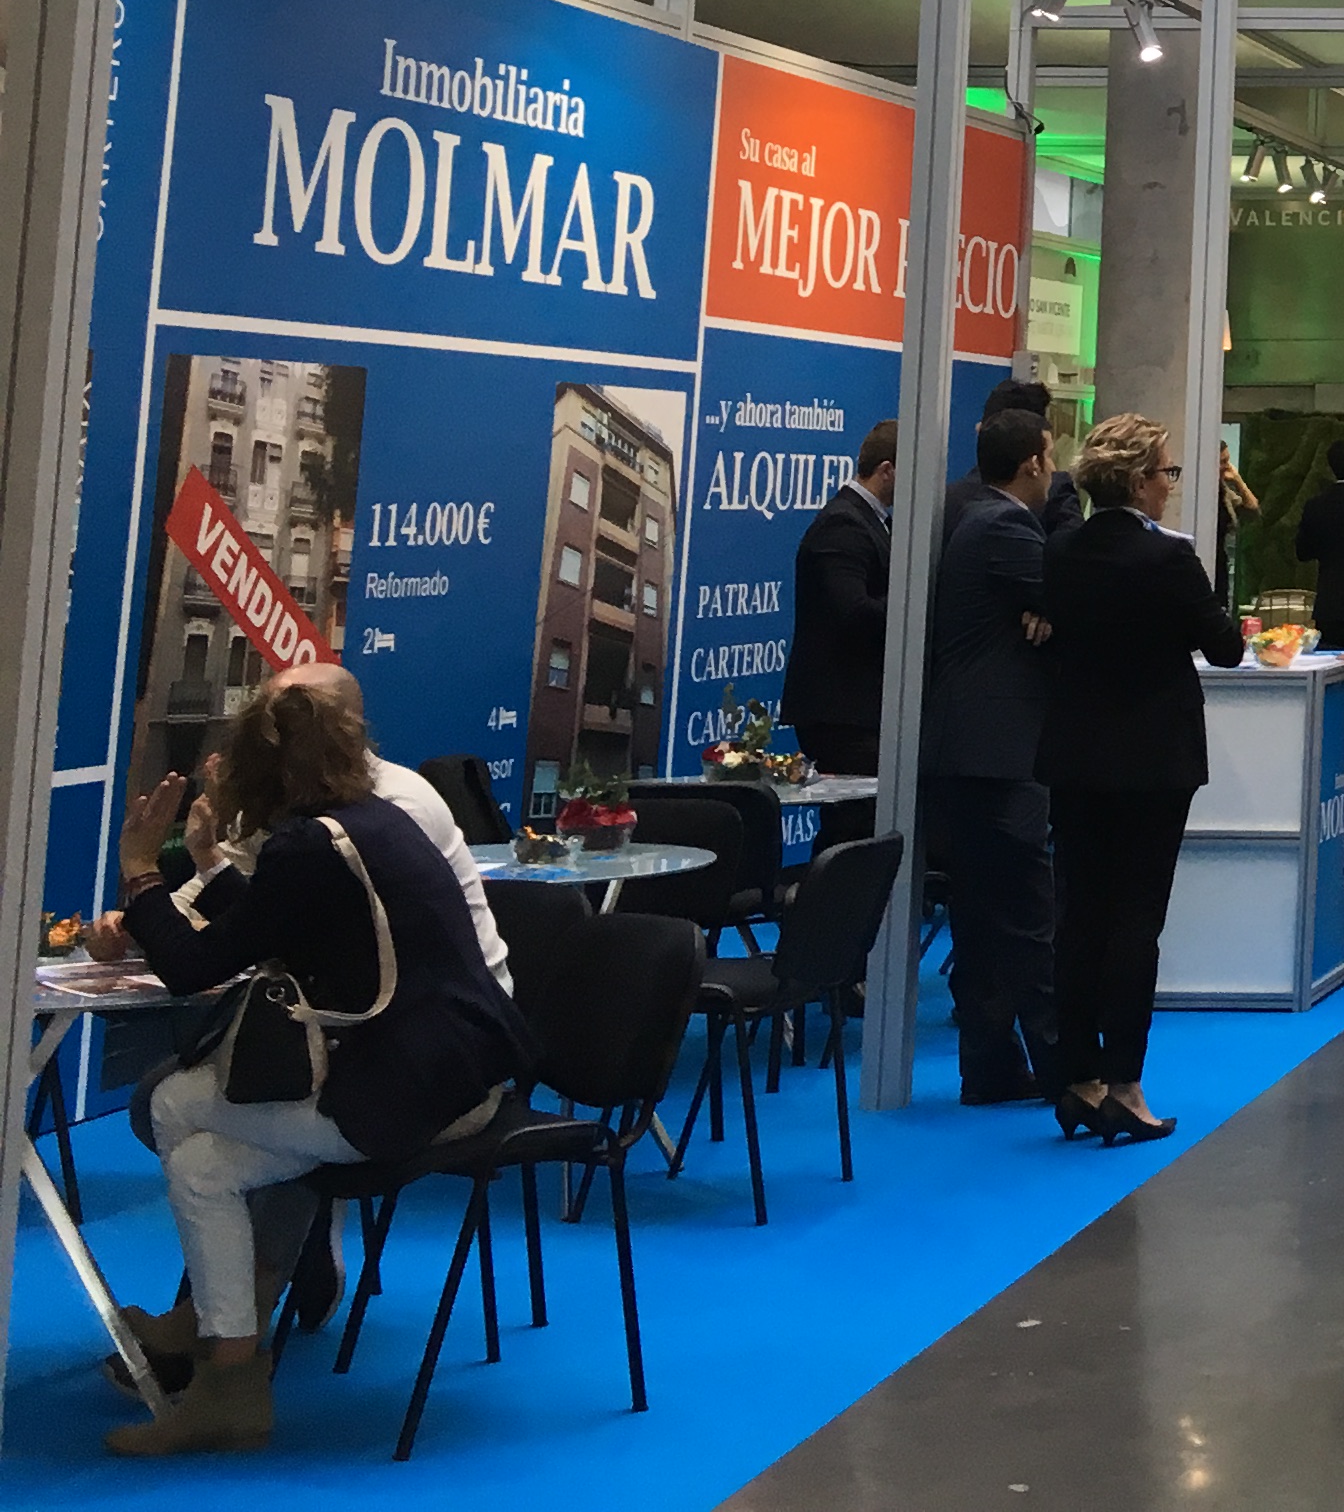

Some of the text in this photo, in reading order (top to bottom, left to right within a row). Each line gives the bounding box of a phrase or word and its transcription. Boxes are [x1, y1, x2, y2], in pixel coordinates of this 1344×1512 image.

[380, 37, 586, 139] Inmobiliaria
[739, 127, 817, 178] Su casa al
[253, 94, 657, 300] MOLMAR
[732, 178, 882, 298] MEJOR
[735, 393, 782, 429] ahora
[785, 398, 844, 432] también
[196, 502, 317, 666] VENDIDO
[365, 567, 449, 599] Reformado
[696, 581, 782, 619] PATRAIX
[362, 627, 375, 654] 2
[690, 639, 787, 683] CARTEROS
